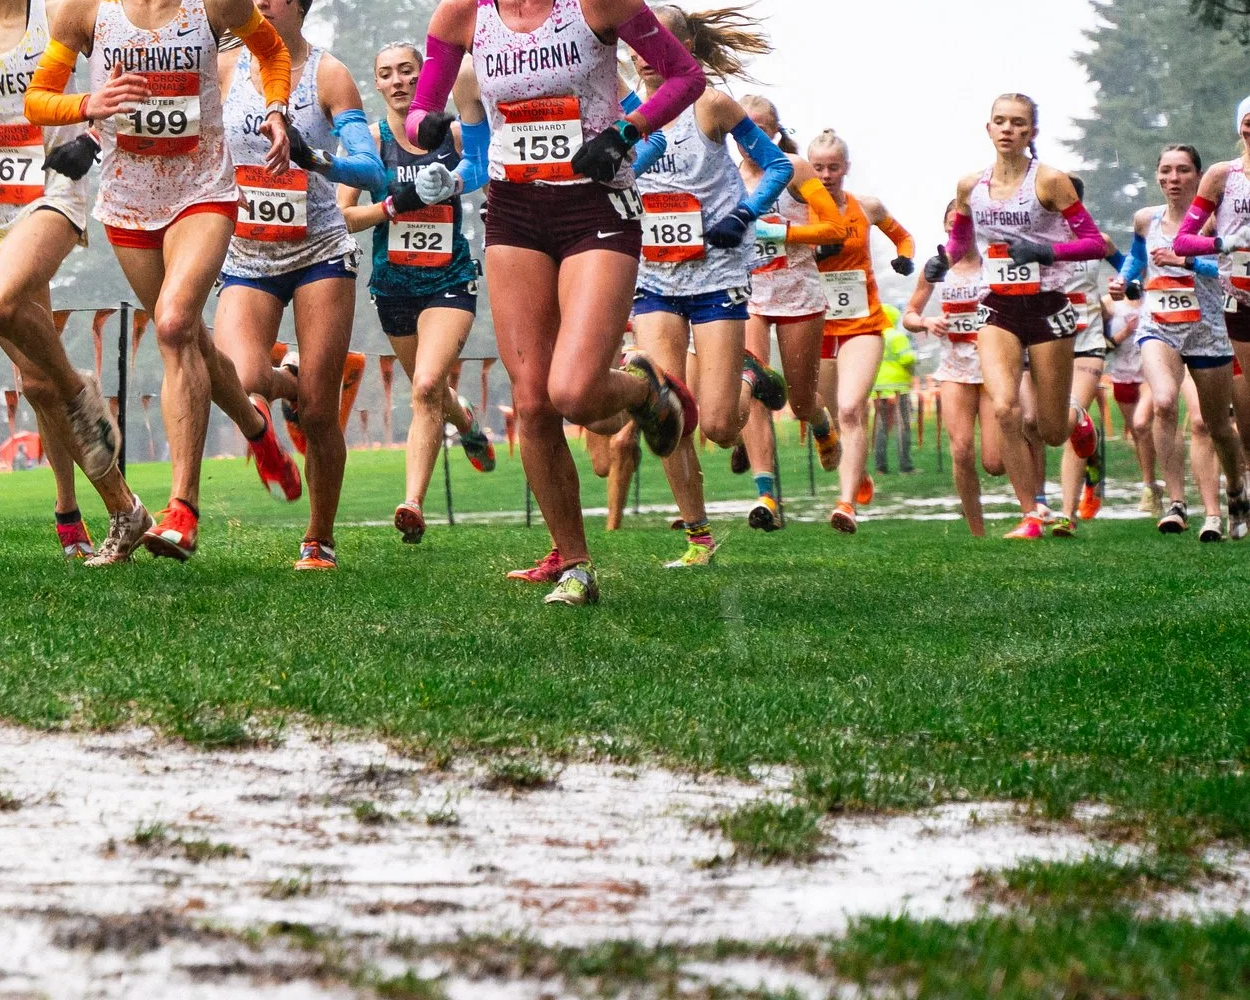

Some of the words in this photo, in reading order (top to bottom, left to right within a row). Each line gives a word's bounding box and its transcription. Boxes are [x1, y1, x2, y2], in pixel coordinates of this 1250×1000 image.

[104, 46, 203, 71] SOUTHWEST
[486, 41, 582, 78] CALIFORNIA
[153, 74, 188, 83] CROSS
[531, 100, 565, 108] CROSS
[129, 110, 188, 135] 199
[511, 124, 567, 132] ENGELHARDT
[513, 135, 571, 161] 158
[648, 153, 677, 174] UTH
[248, 199, 295, 223] 190
[975, 211, 1031, 226] CALIFORNIA
[400, 231, 443, 251] 132
[650, 223, 692, 244] 188
[753, 241, 778, 257] 96
[997, 266, 1031, 282] 159
[838, 292, 849, 306] 8
[942, 287, 978, 300] HEARTLA
[1158, 295, 1192, 310] 186
[954, 319, 973, 332] 16
